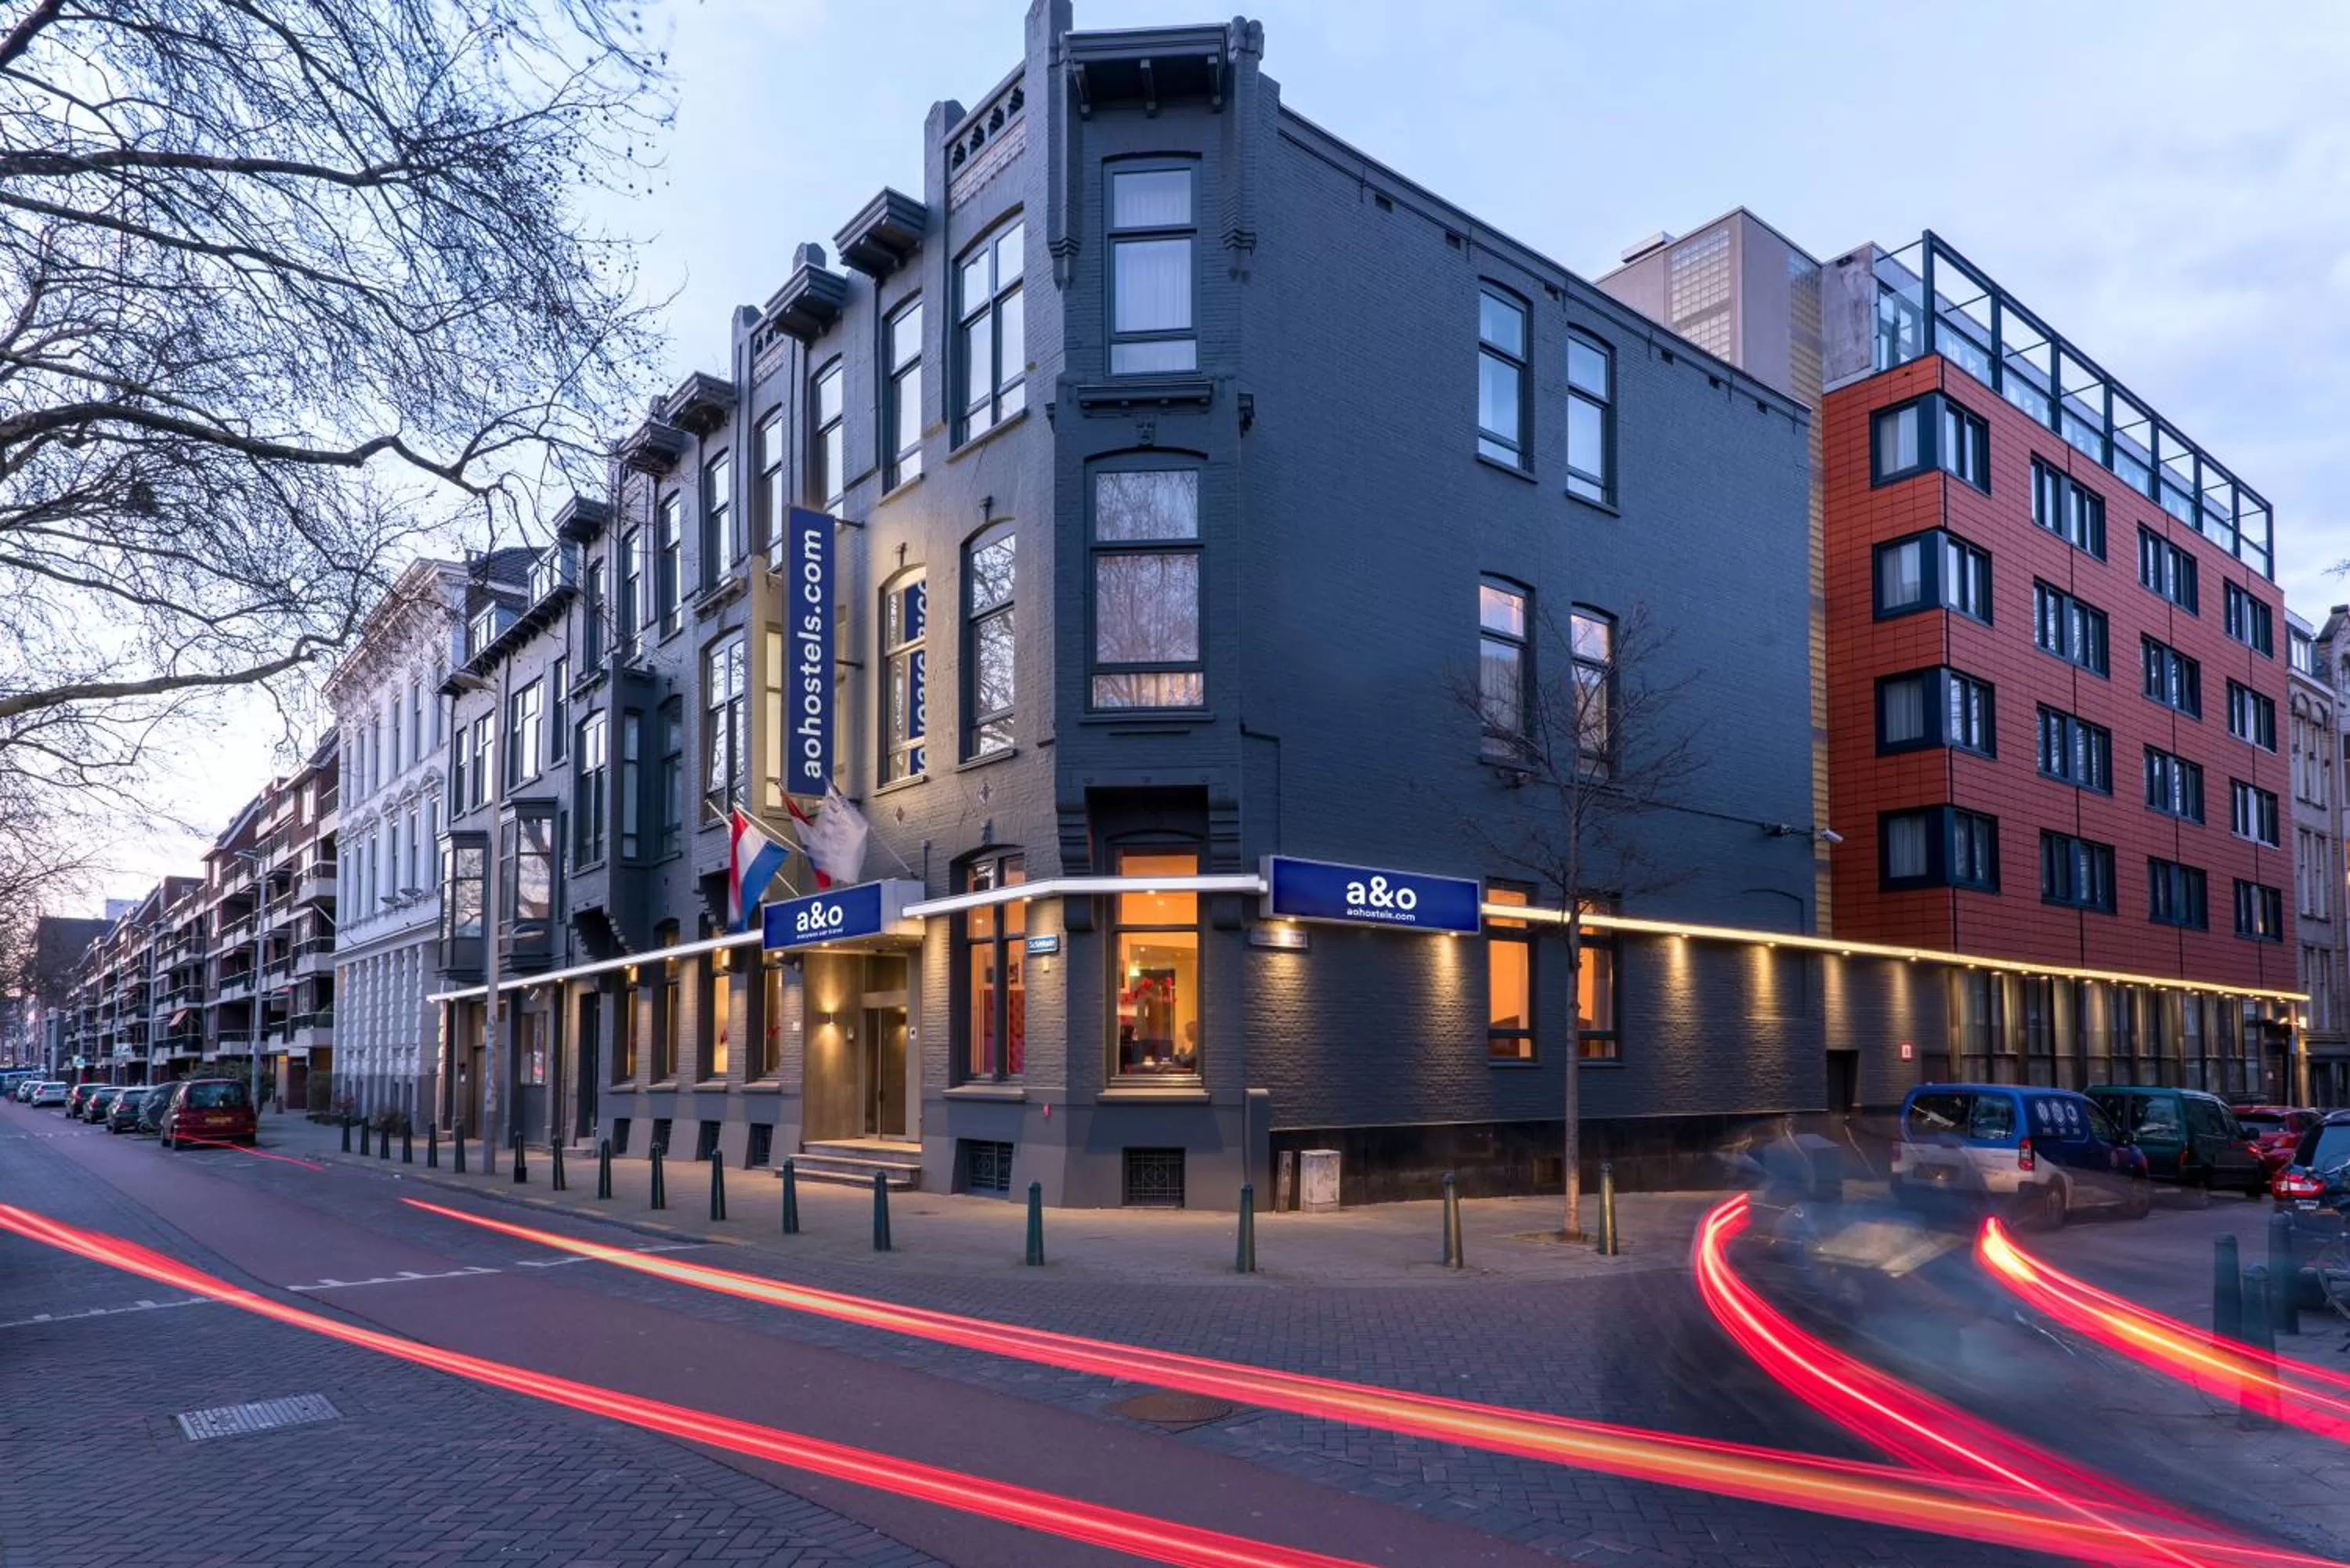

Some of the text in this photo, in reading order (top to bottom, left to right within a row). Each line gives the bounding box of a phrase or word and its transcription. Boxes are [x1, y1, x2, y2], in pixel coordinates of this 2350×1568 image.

[797, 529, 822, 779] aohostels.com
[1347, 876, 1417, 910] a&o
[797, 902, 843, 931] a&o
[1347, 909, 1415, 920] aohostels.com
